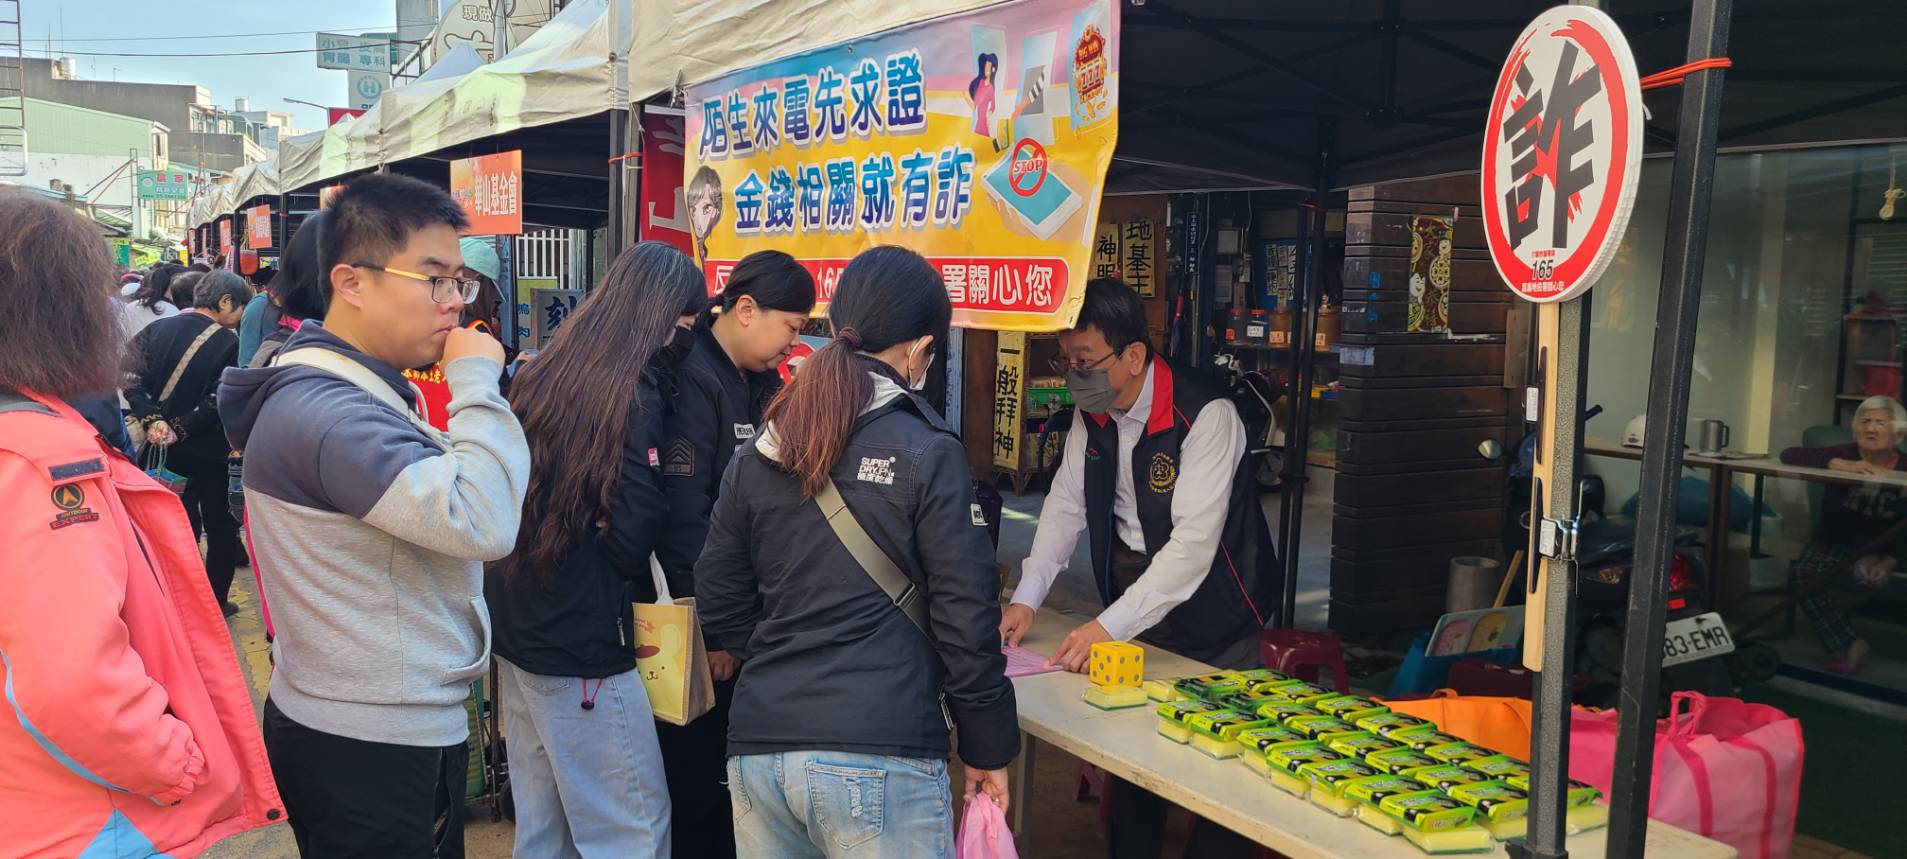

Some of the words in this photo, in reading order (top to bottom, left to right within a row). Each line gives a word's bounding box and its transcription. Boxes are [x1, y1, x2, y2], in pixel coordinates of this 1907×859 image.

[700, 51, 926, 155] 陌生來電先求證
[1014, 159, 1043, 173] STOP
[1503, 40, 1602, 251] 詐
[735, 147, 973, 230] 金錢相關就有詐
[941, 264, 1053, 307] 署關心您
[1125, 219, 1153, 297] 地基主
[1532, 259, 1554, 279] 165
[995, 347, 1021, 459] 一般拜神
[861, 456, 890, 468] SUPER
[1663, 626, 1729, 657] 83-EMR
